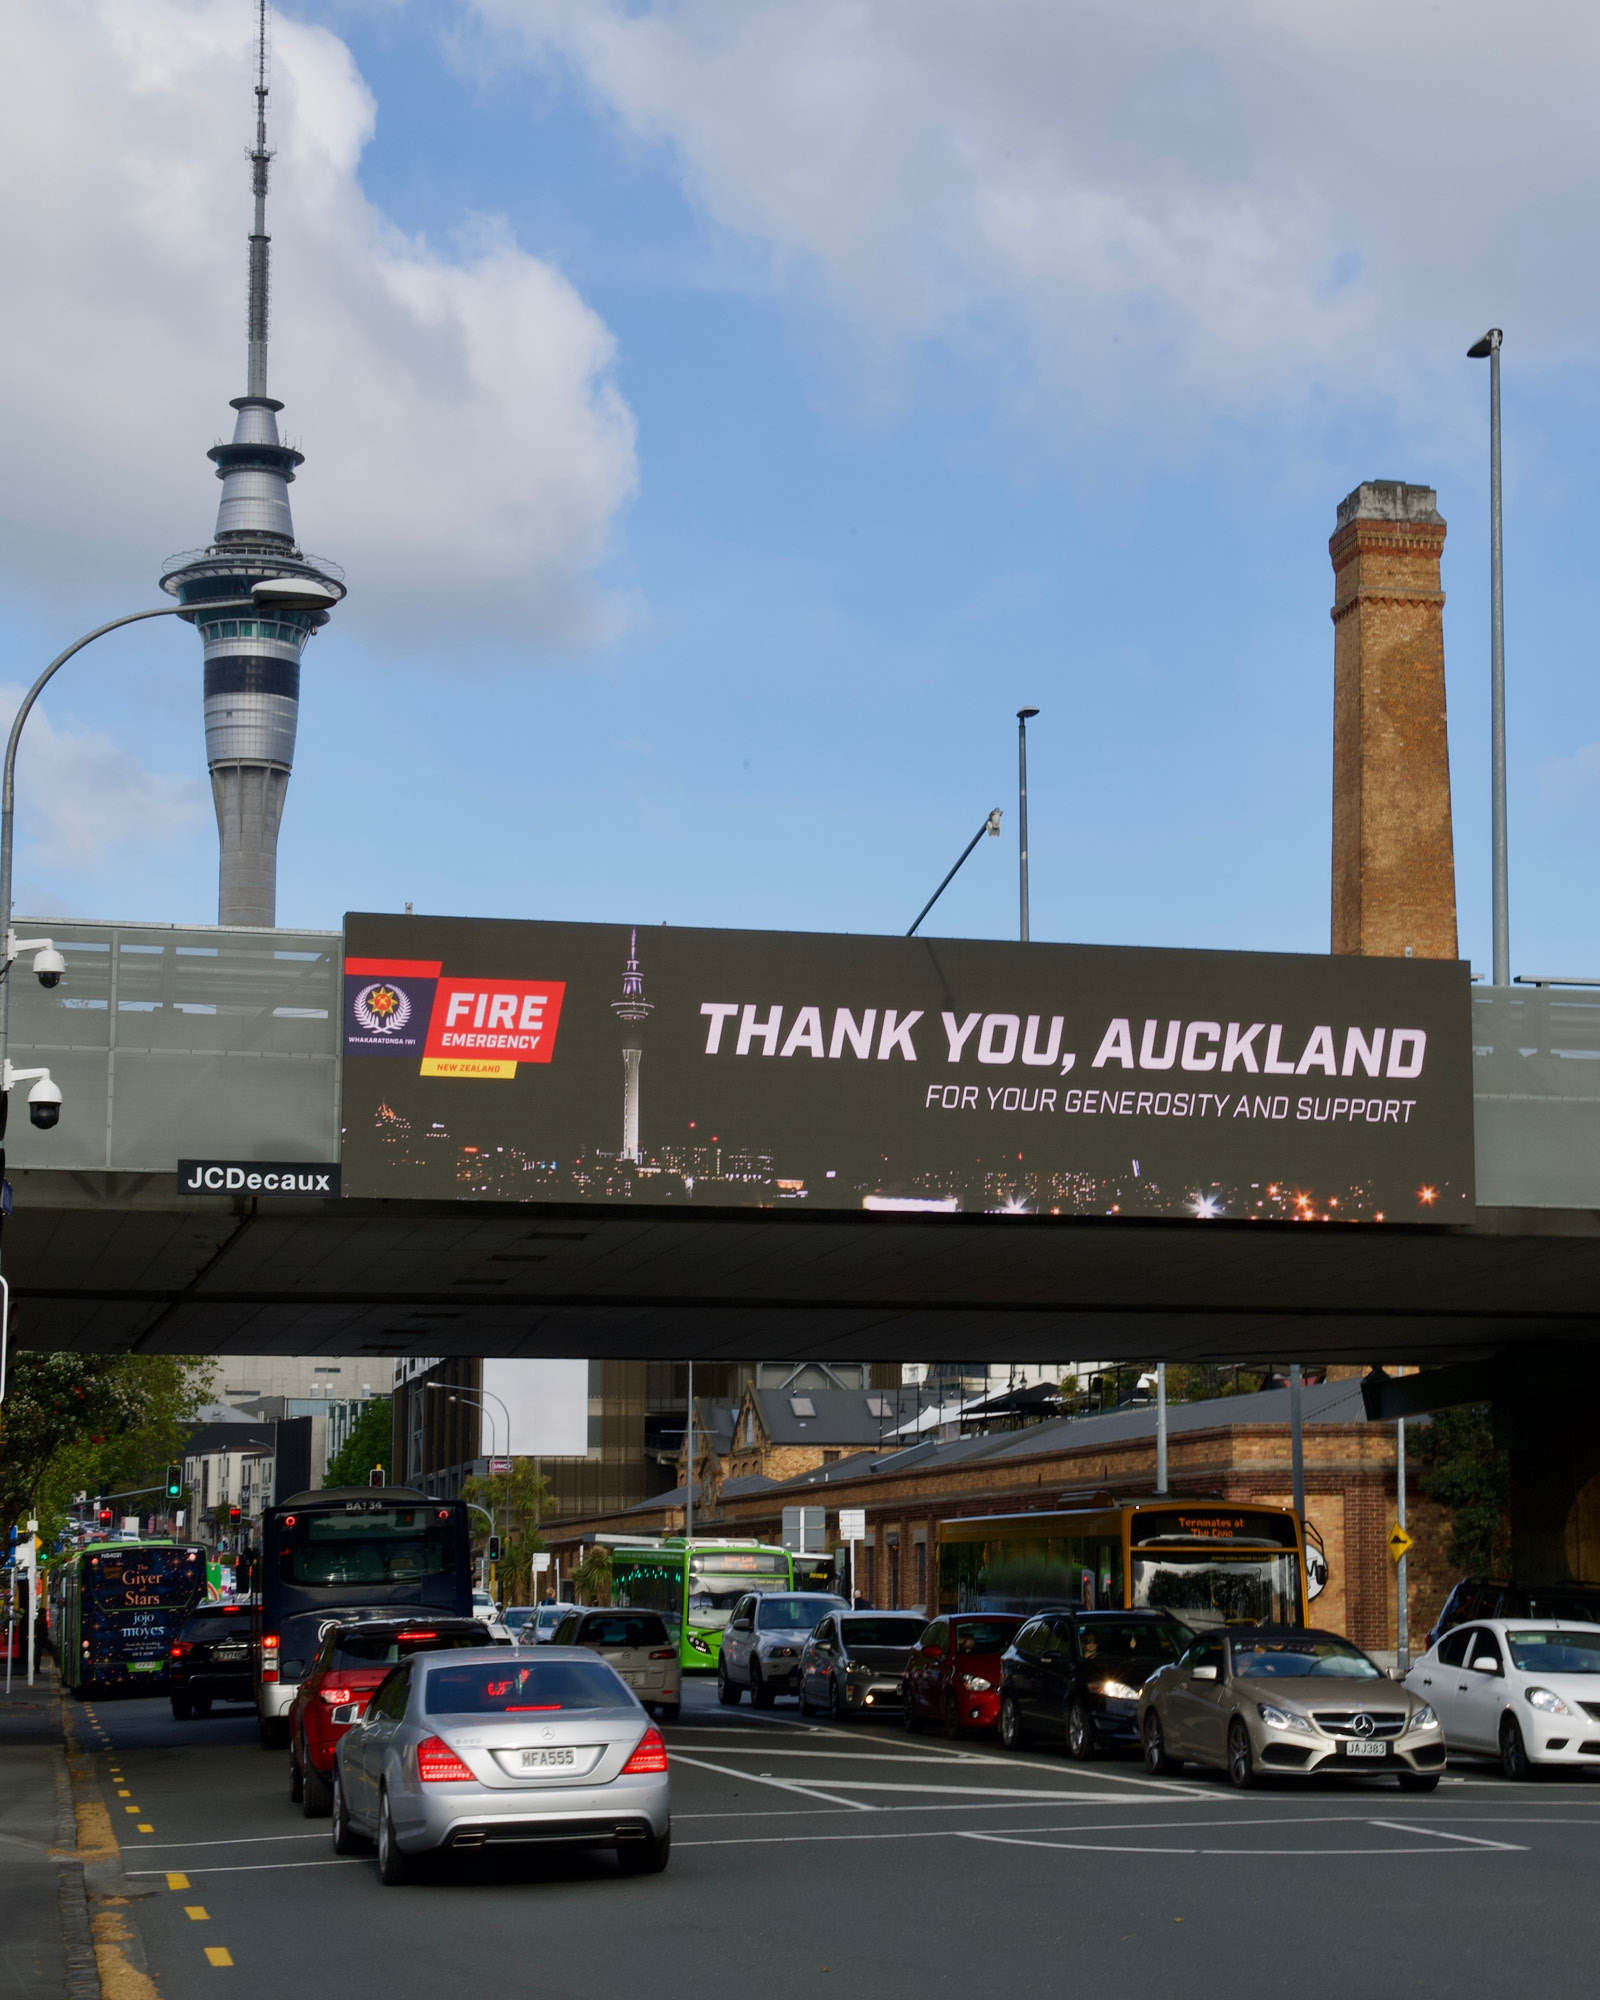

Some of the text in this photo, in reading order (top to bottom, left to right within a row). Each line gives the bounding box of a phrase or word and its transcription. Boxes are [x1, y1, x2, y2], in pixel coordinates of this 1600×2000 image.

[445, 992, 548, 1030] FIRE
[348, 1036, 404, 1045] WHAKARATONGA
[441, 1032, 540, 1049] EMERGENCY
[700, 1002, 1427, 1079] THANK YOU, AUCKLAND
[436, 1063, 501, 1073] NEW ZEALAND
[926, 1084, 1417, 1123] FOR YOUR GENEROSITY AND SUPPORT
[187, 1166, 330, 1191] JCDecaux
[1178, 1517, 1245, 1528] Terminates at
[1190, 1528, 1210, 1538] The
[122, 1570, 162, 1585] Giver
[124, 1591, 160, 1605] Stars
[133, 1611, 155, 1626] jojo
[121, 1626, 165, 1639] moyes
[1347, 1742, 1385, 1755] JAJ383
[521, 1750, 575, 1767] MFA555
